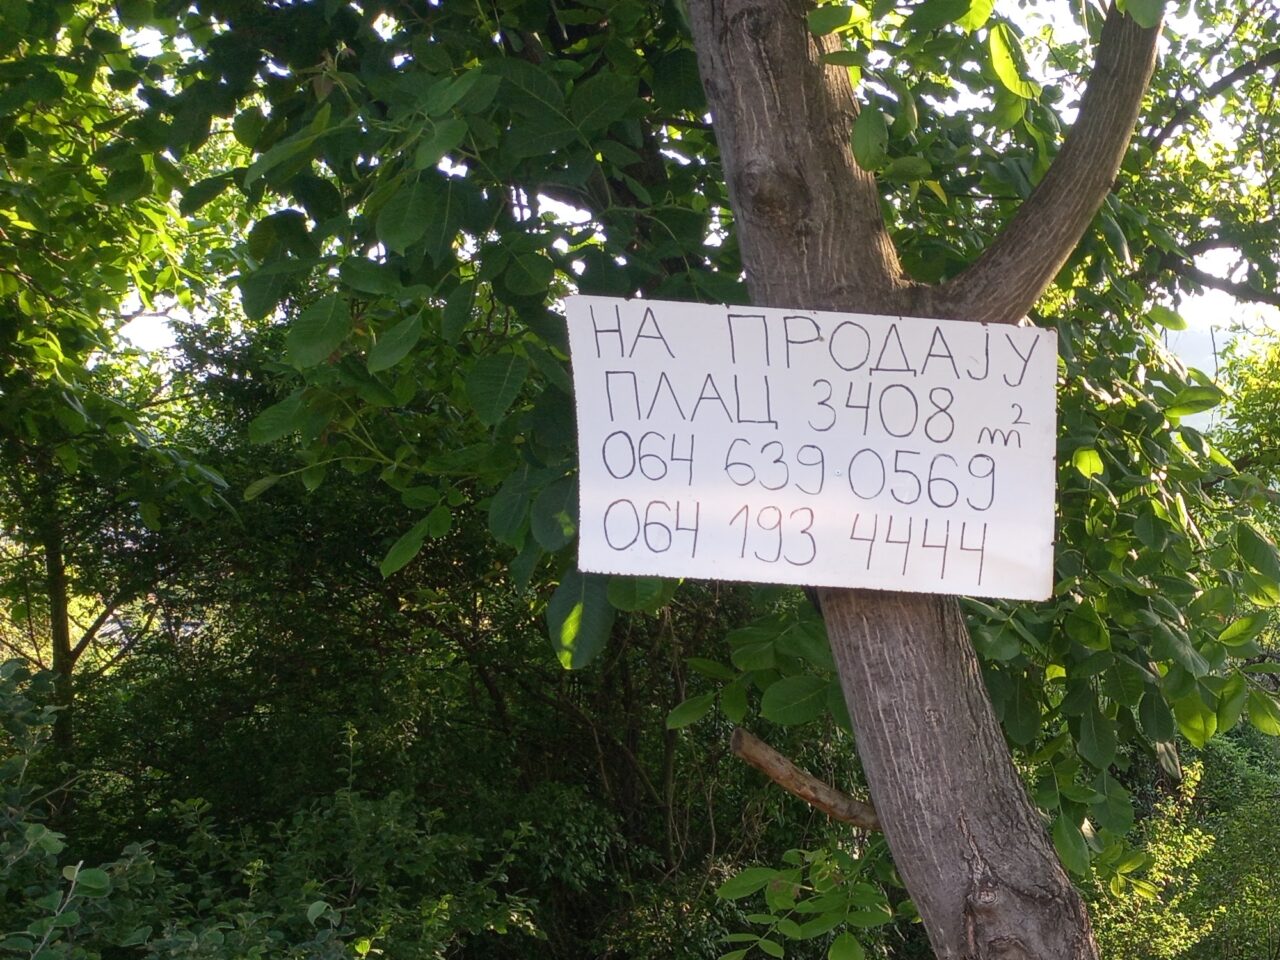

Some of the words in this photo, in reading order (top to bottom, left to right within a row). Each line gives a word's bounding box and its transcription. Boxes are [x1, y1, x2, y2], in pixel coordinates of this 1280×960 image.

[590, 304, 675, 359] НА
[604, 370, 778, 430] ПЛАЦ
[808, 379, 955, 443] 3408
[602, 430, 695, 486] 064
[724, 438, 825, 495] 639
[848, 448, 996, 512] 0569
[603, 498, 700, 559] 064
[729, 504, 817, 567] 193
[849, 513, 988, 586] 4444
